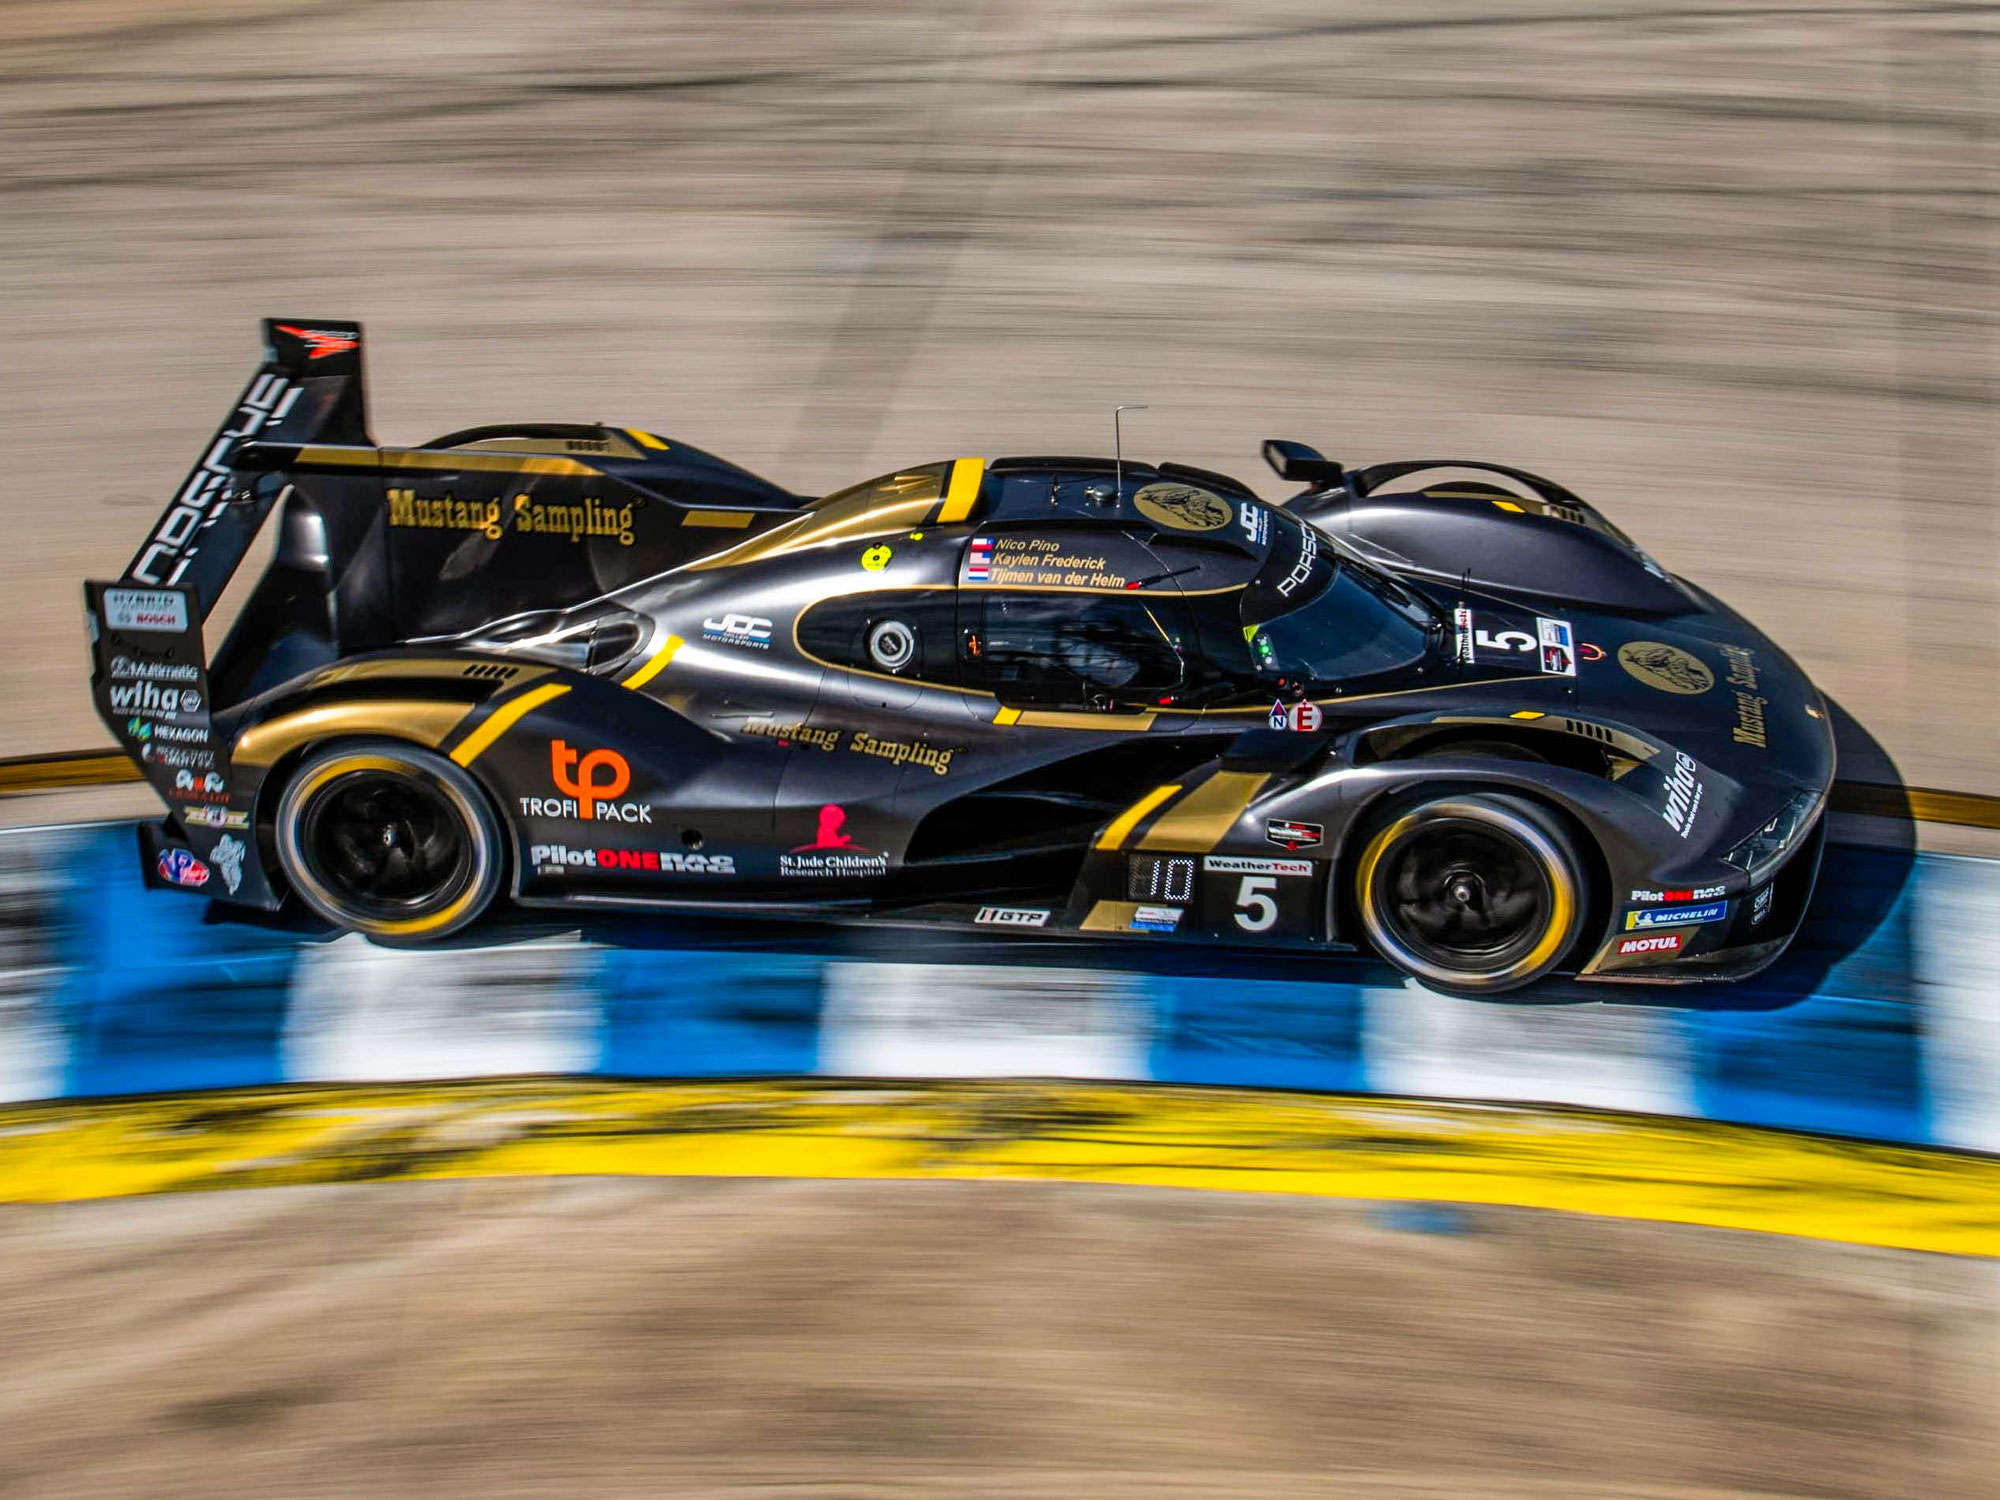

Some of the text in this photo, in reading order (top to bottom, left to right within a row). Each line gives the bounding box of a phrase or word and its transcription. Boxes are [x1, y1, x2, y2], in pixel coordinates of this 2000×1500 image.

[386, 488, 635, 546] Mustang Sampling
[995, 539, 1060, 552] Nico Pino
[993, 552, 1106, 571] Kaylen Frederick
[990, 568, 1126, 588] Tijmen van der Helm
[703, 613, 773, 638] JDC
[1475, 630, 1538, 651] 5
[1273, 716, 1284, 728] N
[1297, 707, 1313, 732] E
[1730, 689, 1768, 748] Mustang
[154, 724, 209, 743] HEXAGON
[742, 716, 954, 776] Mustang Sampling
[1662, 762, 1695, 832] wiha
[520, 797, 652, 823] TROFI PACK
[1208, 859, 1309, 872] WeatherTech
[1233, 875, 1278, 932] 5
[1655, 908, 1718, 922] MICHELIN
[1620, 937, 1678, 953] MOTUL
